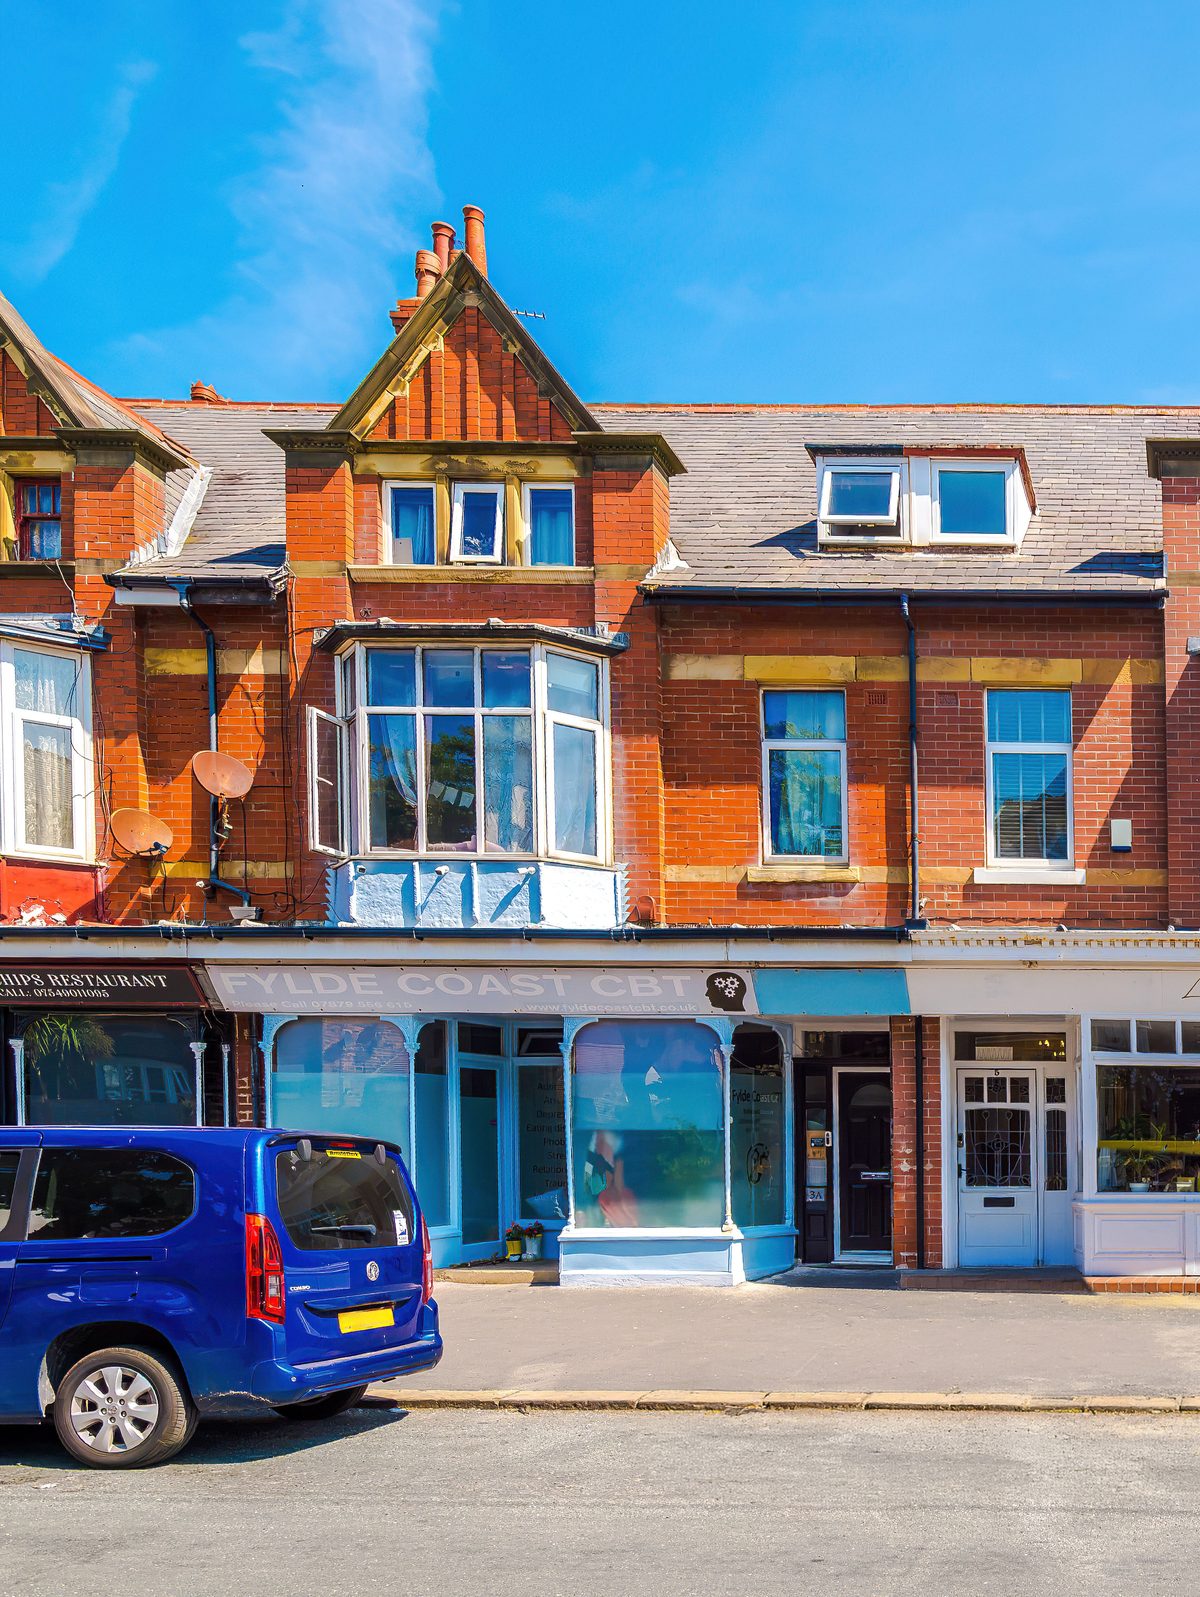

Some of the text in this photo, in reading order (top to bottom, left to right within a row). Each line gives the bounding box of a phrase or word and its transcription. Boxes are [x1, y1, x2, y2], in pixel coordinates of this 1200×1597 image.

[0, 974, 168, 988] HIPS RESTAURANT
[220, 972, 691, 997] FYLDE COAST CBT
[281, 1000, 308, 1009] Call
